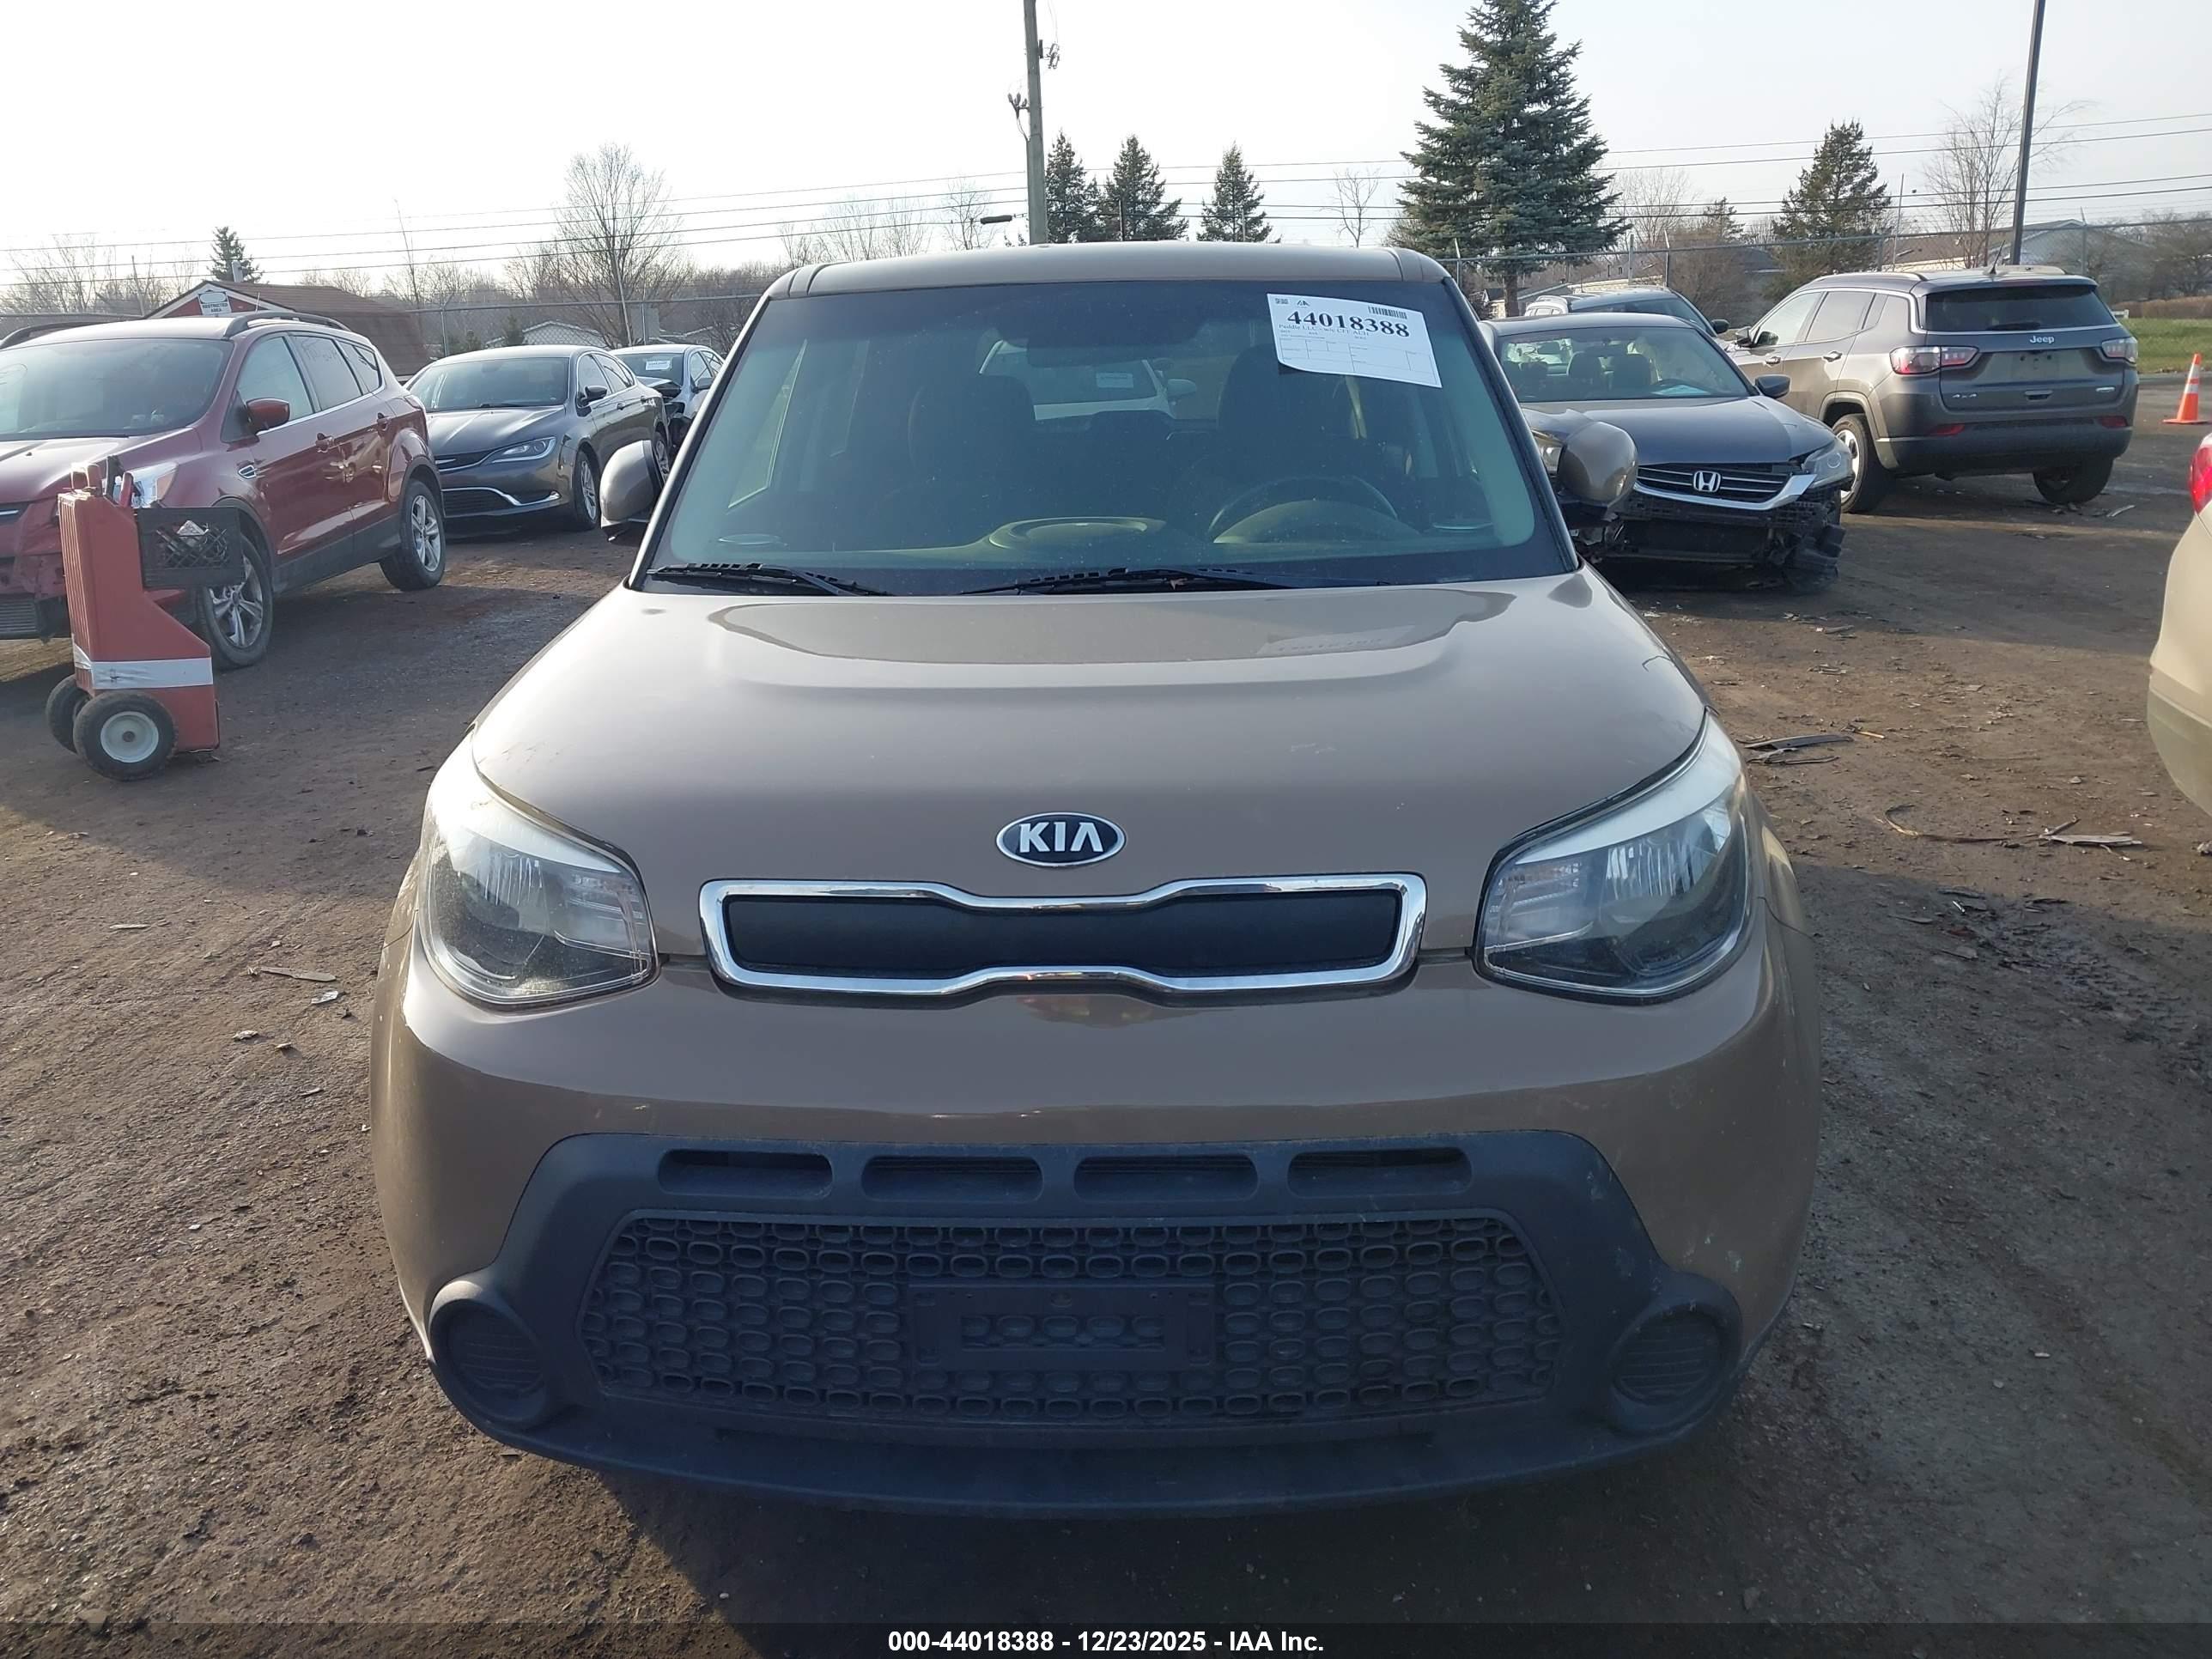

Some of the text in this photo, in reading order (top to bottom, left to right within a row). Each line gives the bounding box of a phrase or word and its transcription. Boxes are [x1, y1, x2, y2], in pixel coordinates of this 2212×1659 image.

[1287, 310, 1410, 337] 44018388
[2029, 335, 2055, 343] Jeep
[1019, 822, 1104, 853] KIA
